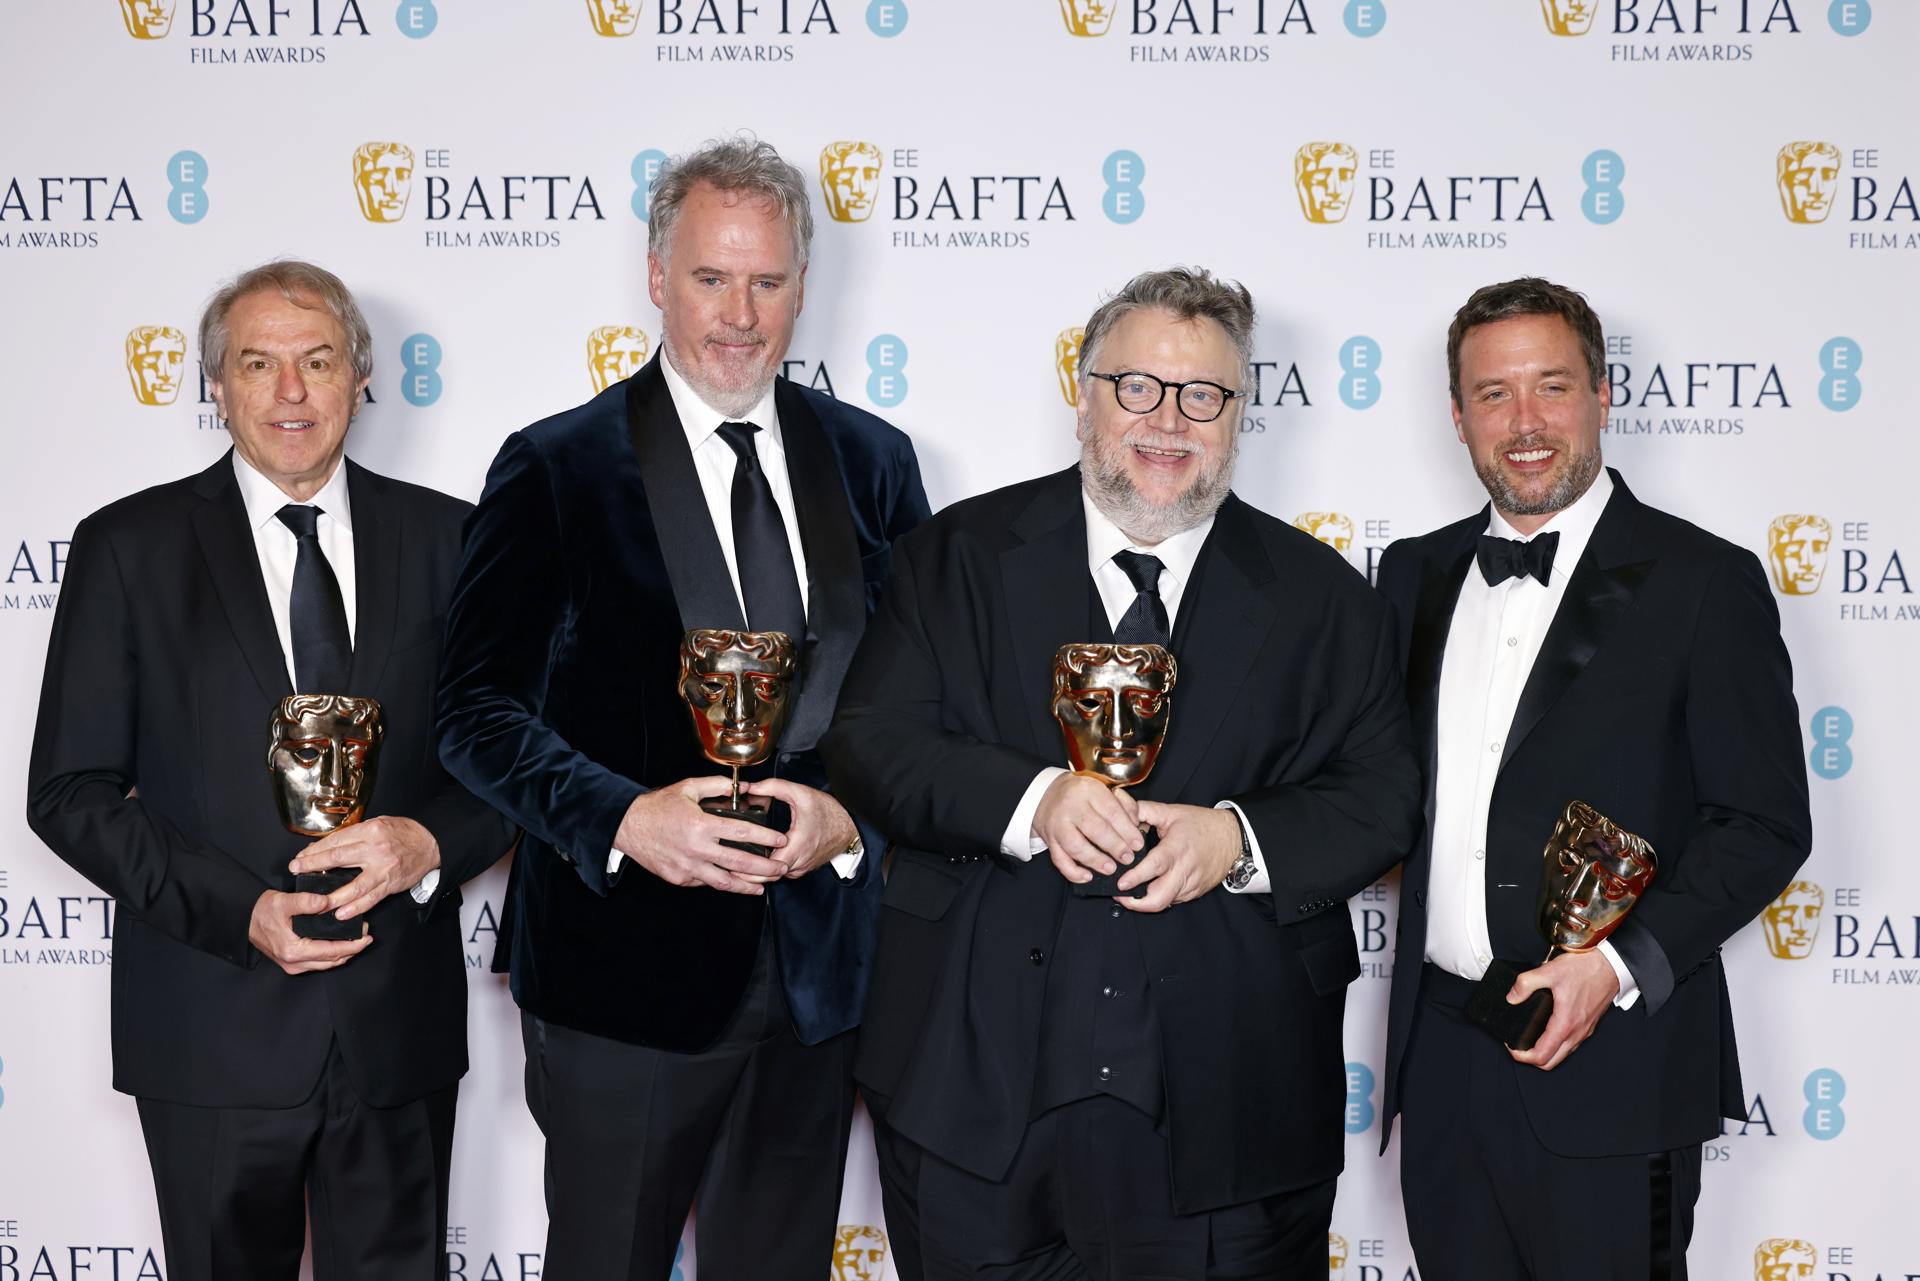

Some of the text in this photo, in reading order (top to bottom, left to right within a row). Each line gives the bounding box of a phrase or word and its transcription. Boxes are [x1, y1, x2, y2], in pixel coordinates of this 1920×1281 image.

[191, 47, 325, 63] FILM AWARDS
[657, 45, 793, 61] FILM AWARDS
[1131, 46, 1269, 61] FILM AWARDS
[1612, 45, 1752, 61] FILM AWARDS
[426, 150, 449, 167] EE
[894, 150, 917, 167] EE
[1370, 150, 1394, 168] EE
[1853, 149, 1878, 168] EE
[425, 176, 606, 220] BAFTA
[893, 176, 1076, 221] BAFTA
[1368, 176, 1554, 221] BAFTA
[18, 232, 98, 247] AWARDS
[426, 232, 560, 247] FILM AWARDS
[893, 232, 1029, 247] FILM AWARDS
[1368, 233, 1506, 248] FILM AWARDS
[1850, 233, 1897, 248] FILM
[1607, 336, 1631, 354] EE
[1608, 362, 1792, 408] BAFTA
[1659, 419, 1743, 434] AWARDS
[1366, 520, 1389, 538] EE
[1844, 523, 1868, 540] EE
[1841, 605, 1887, 619] FILM
[1835, 888, 1859, 906] EE
[0, 896, 117, 940] AFT
[1833, 969, 1879, 984] FILM
[1360, 1240, 1384, 1257] EE
[1828, 1247, 1852, 1264] EE
[446, 1251, 541, 1281] BAF
